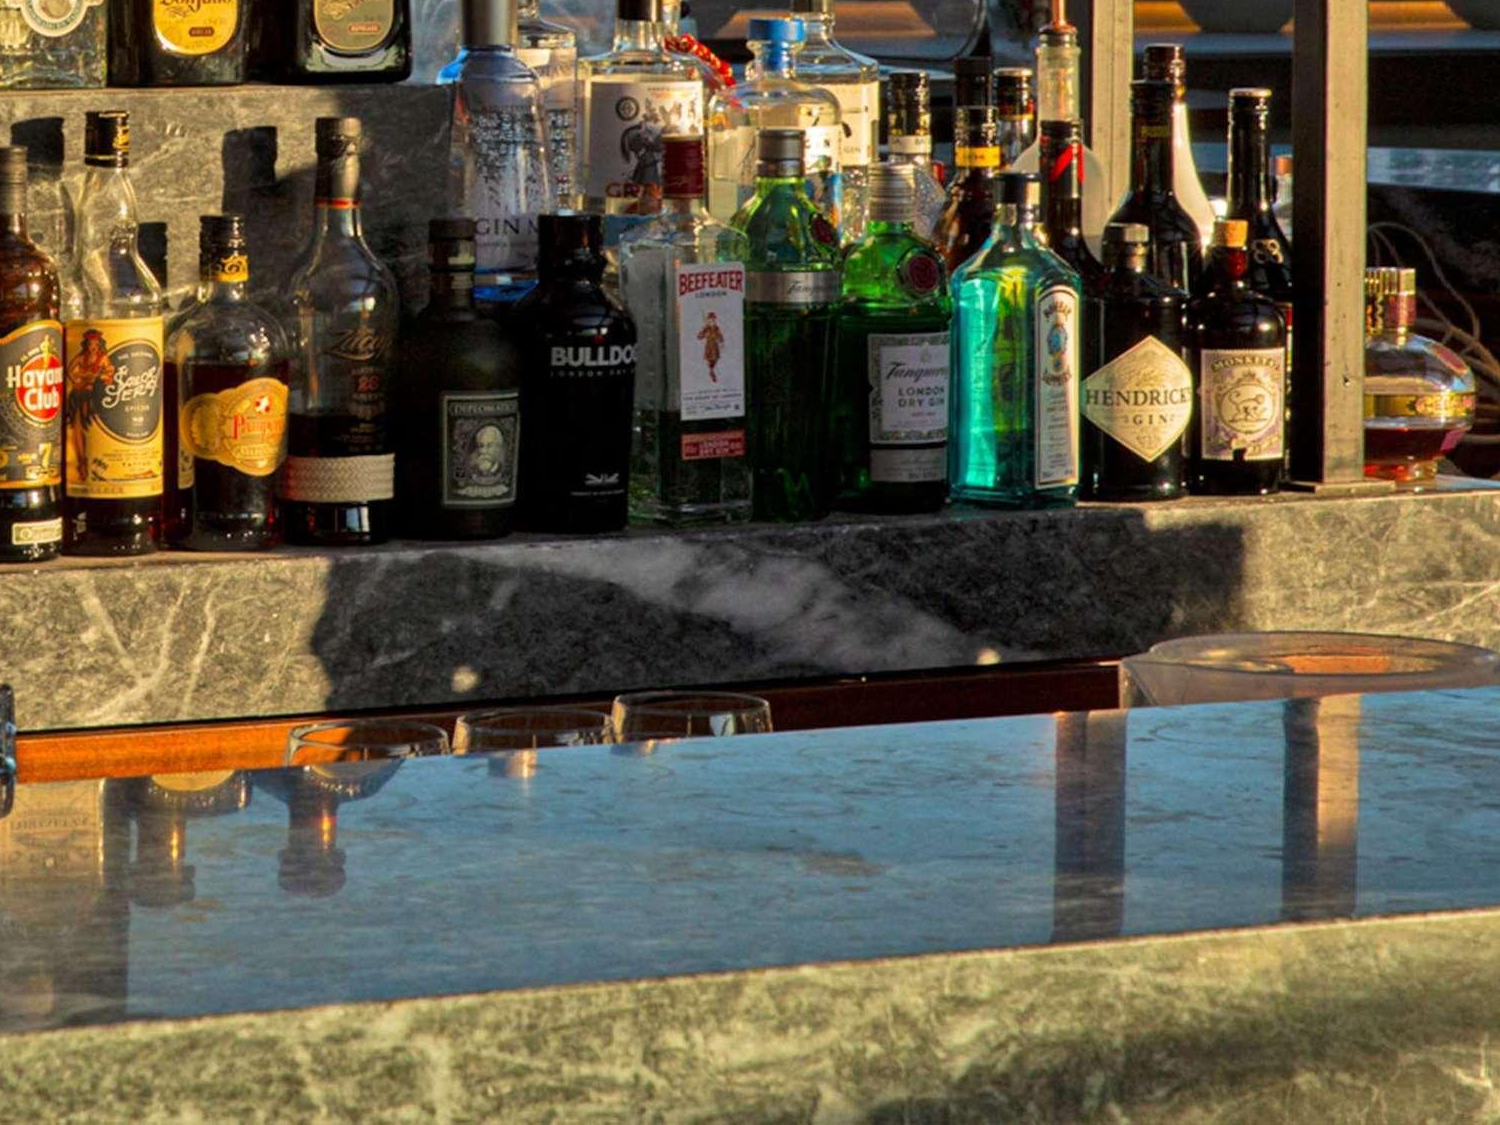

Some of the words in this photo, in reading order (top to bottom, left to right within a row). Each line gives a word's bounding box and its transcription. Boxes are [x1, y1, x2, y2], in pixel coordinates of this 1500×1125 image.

[679, 270, 743, 296] BEEFEATER
[23, 386, 60, 411] Club
[898, 386, 945, 396] LONDON
[898, 397, 923, 408] DRY
[1132, 413, 1169, 425] GIN
[38, 442, 53, 468] 7
